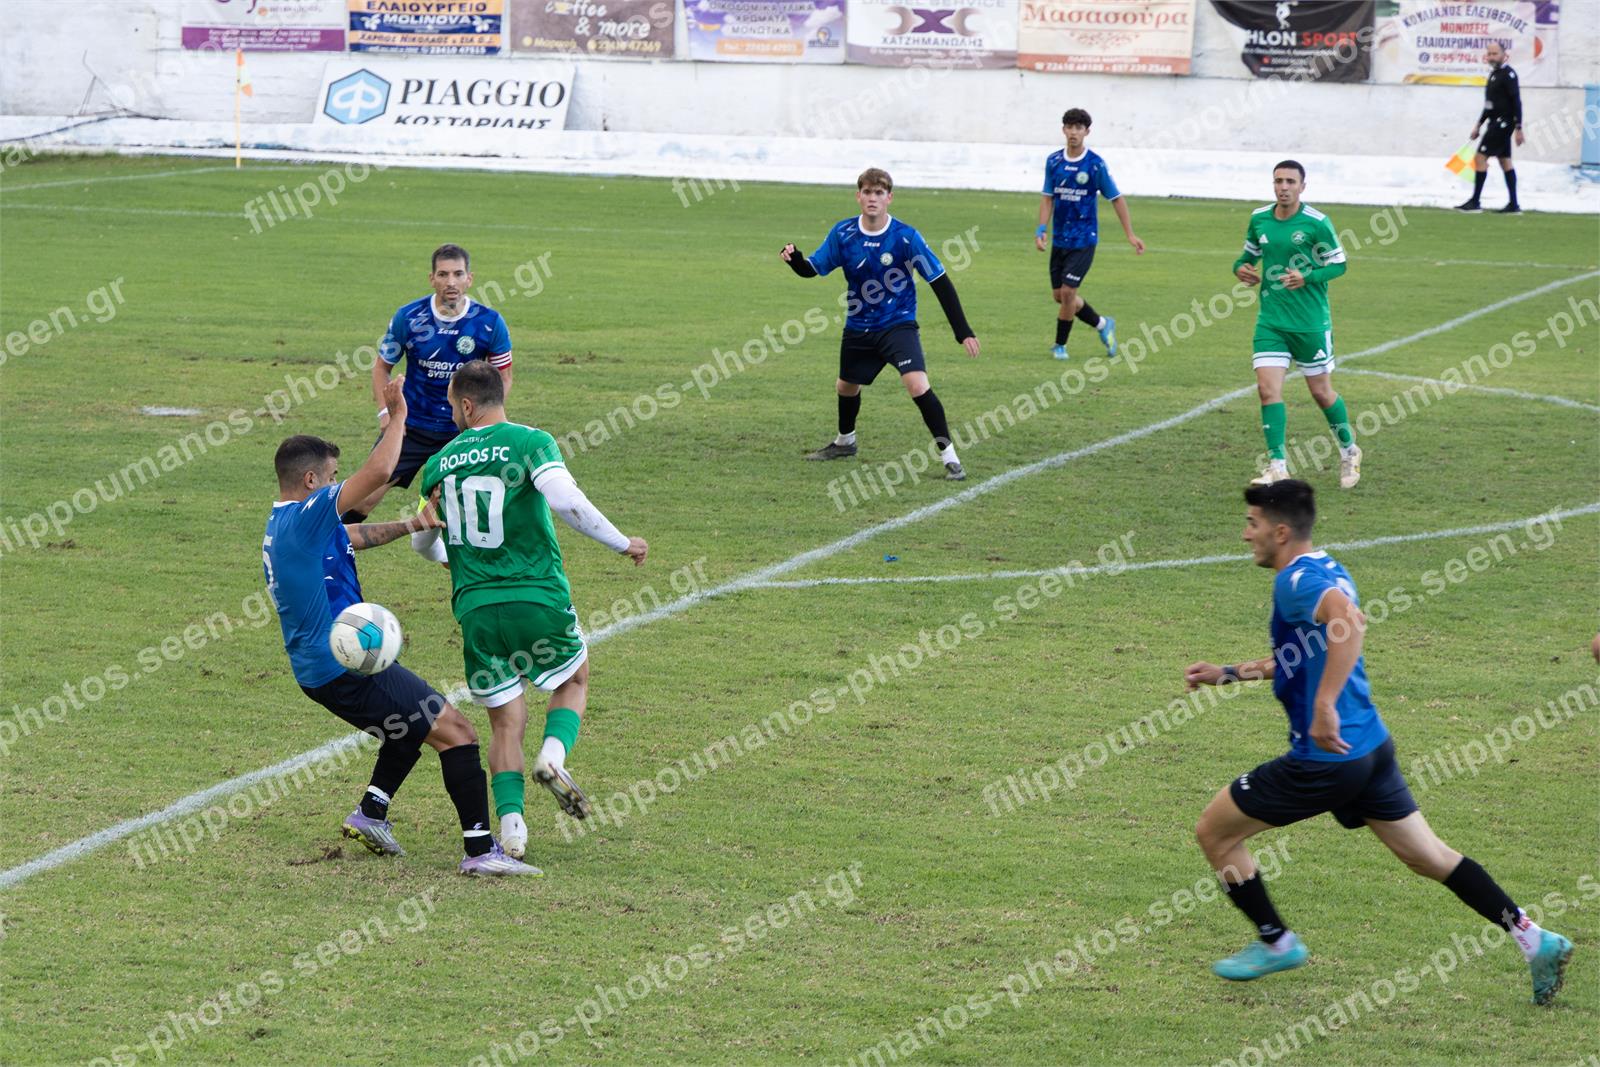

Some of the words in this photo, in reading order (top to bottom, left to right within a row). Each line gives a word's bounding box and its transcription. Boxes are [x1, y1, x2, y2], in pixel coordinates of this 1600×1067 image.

[383, 13, 472, 25] MOLINOVA
[1023, 4, 1189, 28] Μασασούρα
[574, 16, 591, 36] &
[598, 19, 651, 37] more
[1302, 32, 1357, 47] SPORT
[397, 78, 566, 108] PIAGGIO
[418, 360, 455, 371] ENERGY
[491, 446, 510, 462] FC
[443, 474, 506, 549] 10
